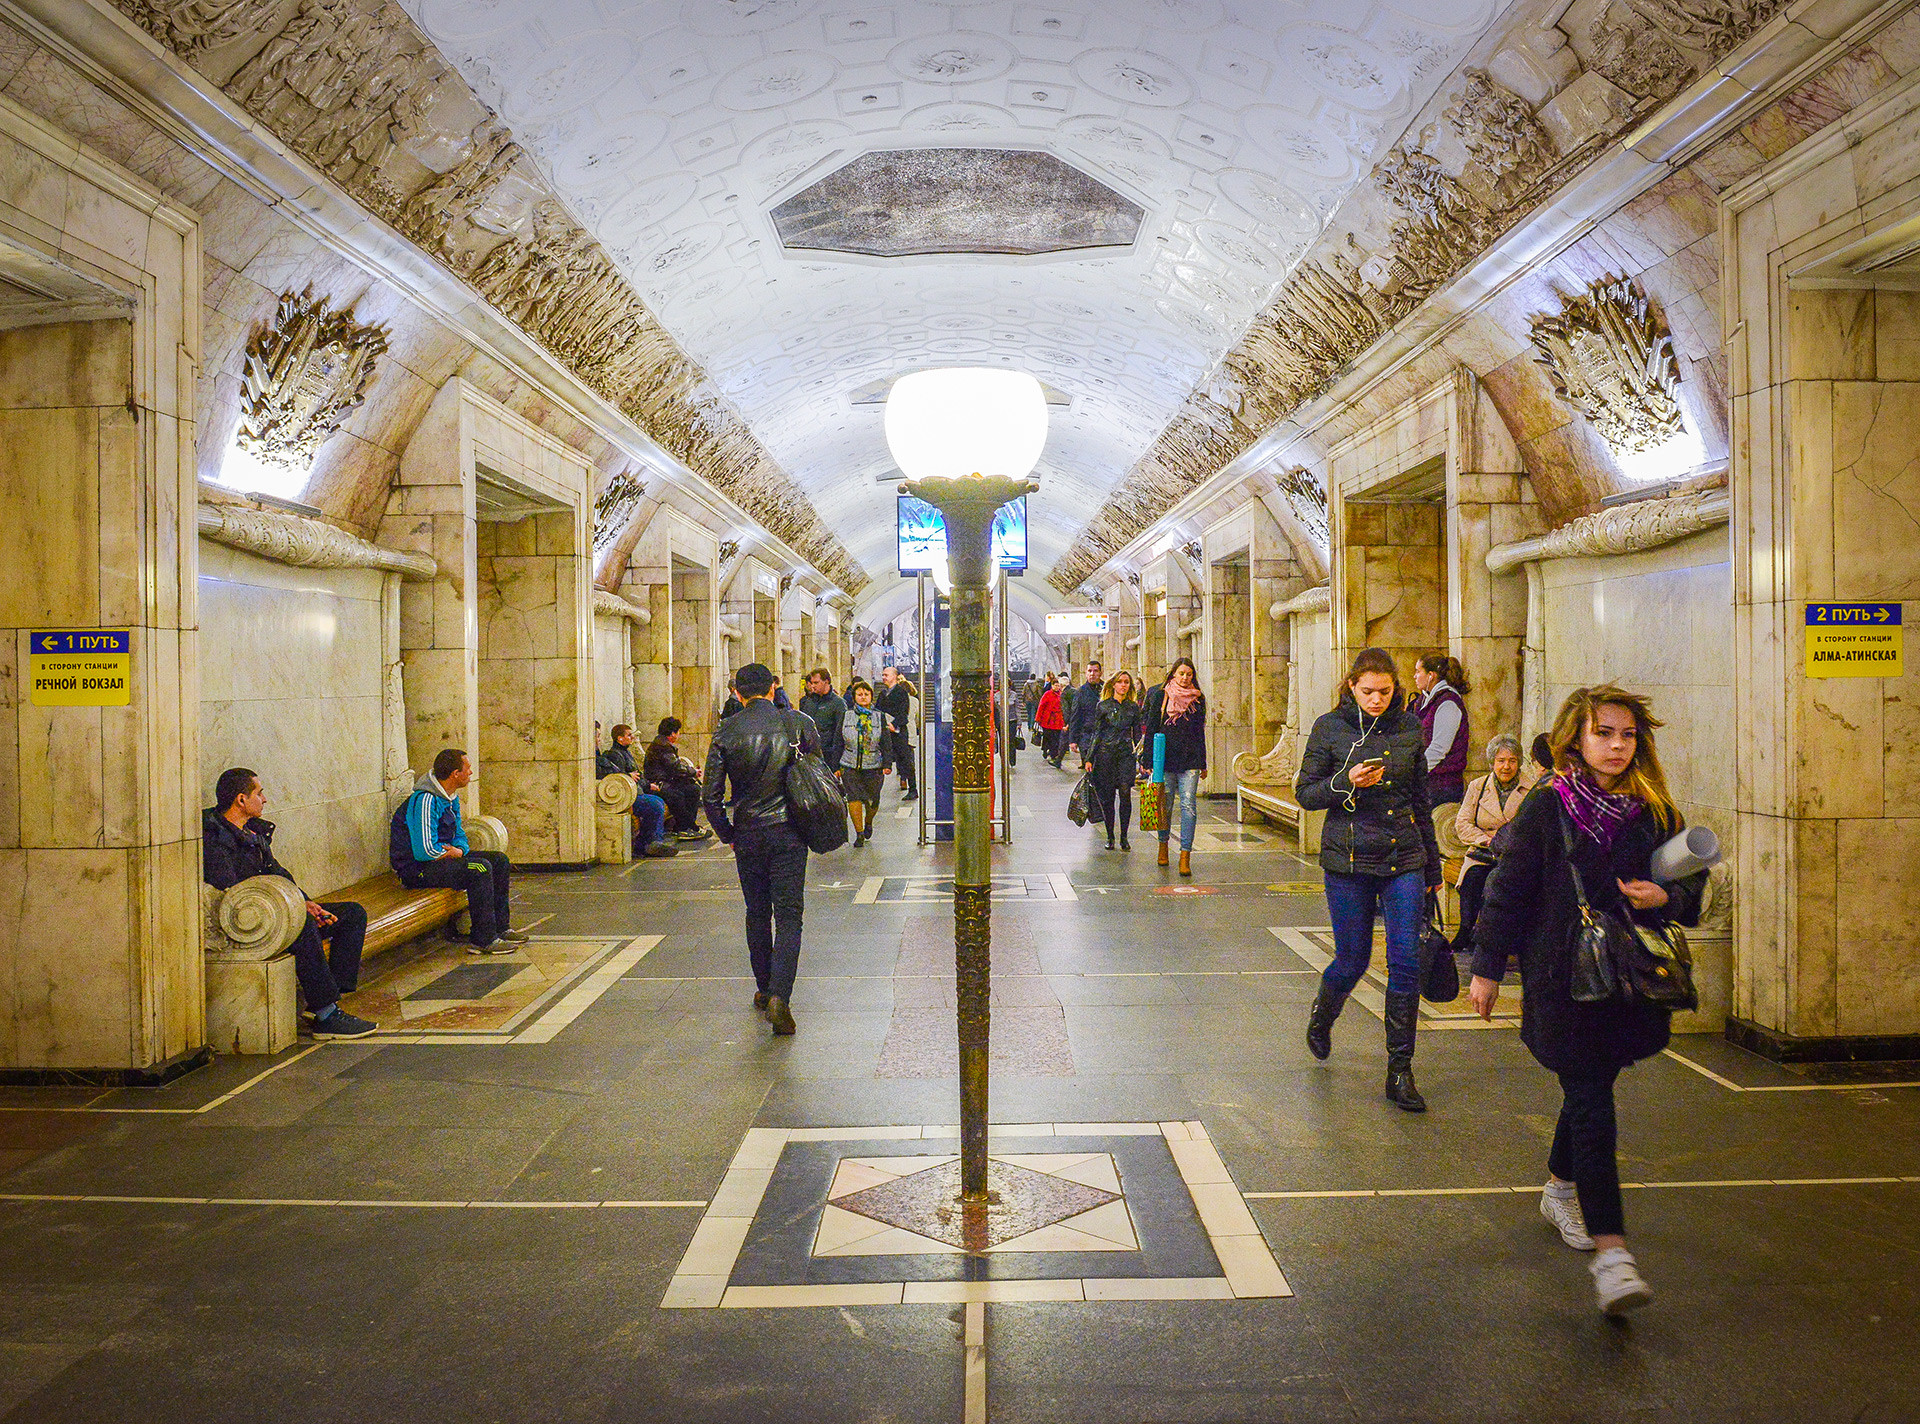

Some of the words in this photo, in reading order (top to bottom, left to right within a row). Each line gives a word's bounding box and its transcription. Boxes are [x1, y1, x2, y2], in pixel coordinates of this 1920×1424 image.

[1816, 607, 1827, 621] 2
[1832, 608, 1871, 621] ПУТЬ
[66, 635, 74, 649] 1
[79, 636, 120, 649] ПУТЬ
[1859, 635, 1892, 643] СТАНЦИИ
[1813, 650, 1897, 662] АЛМА-АТИНСКАЯ
[35, 675, 77, 690] РЕЧНОЙ
[82, 677, 124, 689] ВОКЗАЛ
